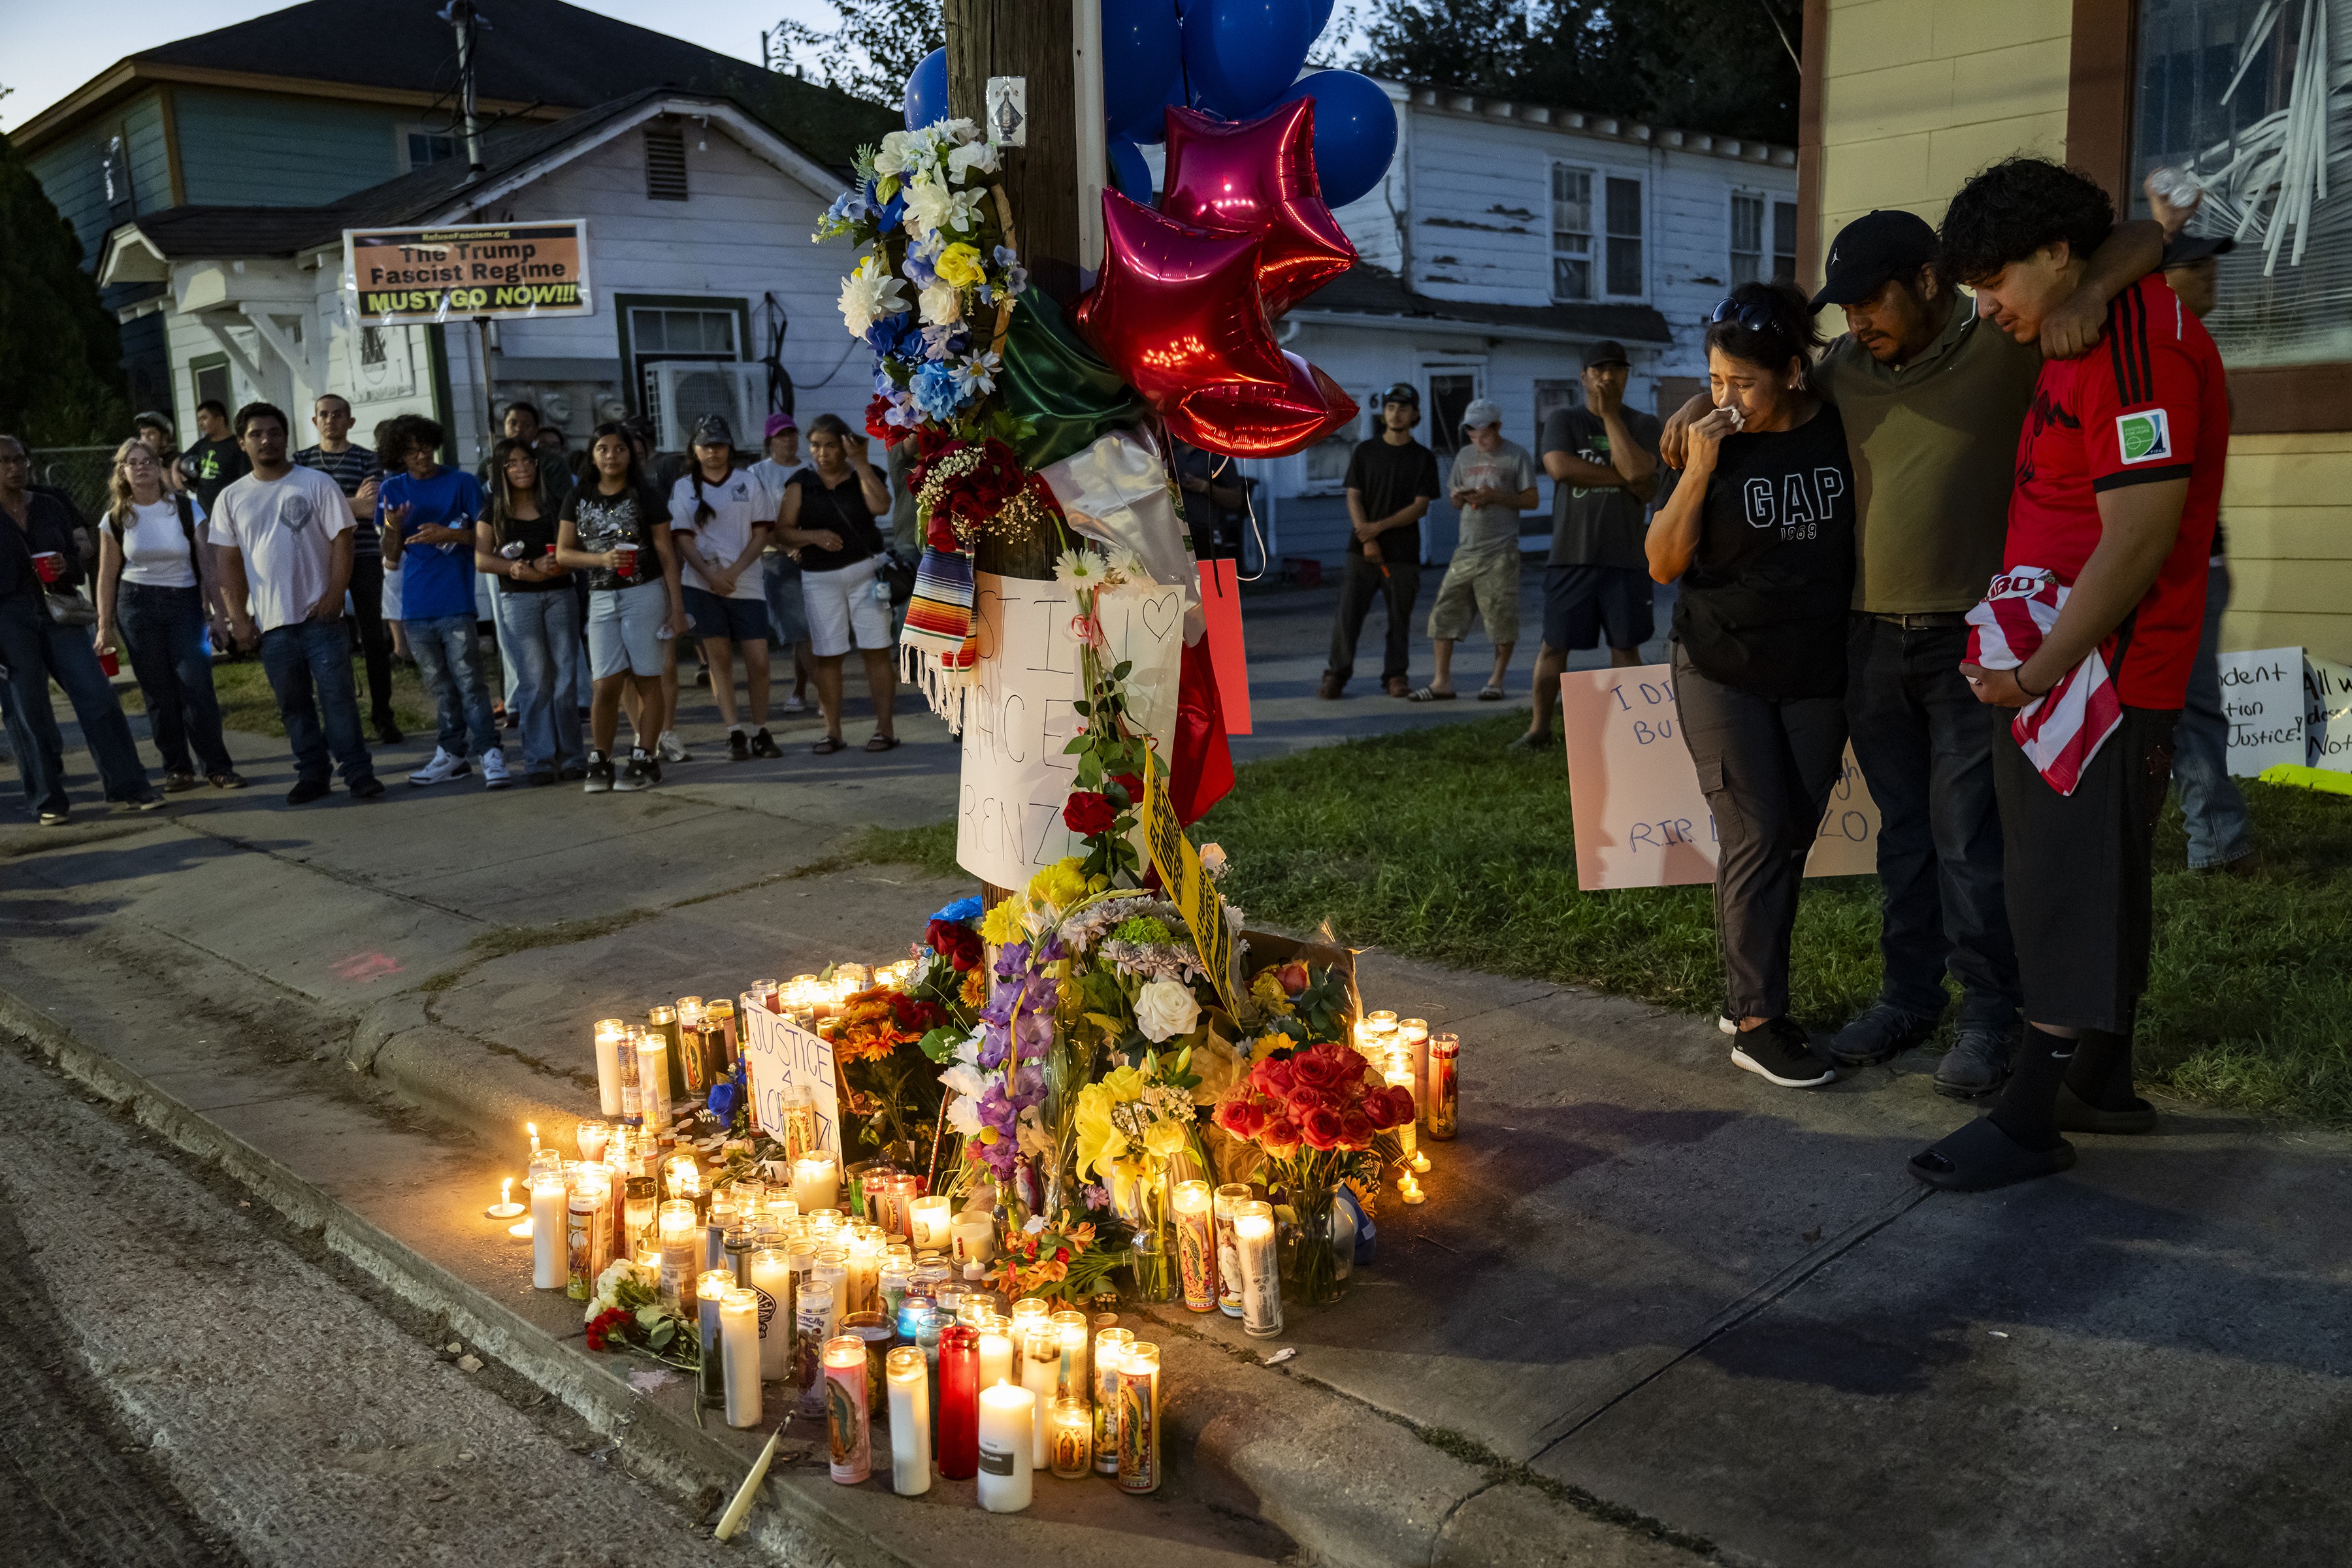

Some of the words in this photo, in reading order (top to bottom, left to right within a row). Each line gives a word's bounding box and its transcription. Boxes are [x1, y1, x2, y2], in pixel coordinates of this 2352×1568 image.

[401, 246, 446, 263] The
[458, 242, 536, 263] Trump
[370, 264, 463, 286] Fascist
[472, 263, 566, 284] Regime
[367, 290, 442, 312] MUST
[449, 288, 488, 306] GO
[495, 284, 577, 305] NOW!!!
[1744, 467, 1844, 529] GAP
[1780, 523, 1817, 542] 1969
[2219, 663, 2287, 686] dent
[2304, 668, 2332, 701] All
[1610, 684, 1632, 711] I
[1634, 719, 1679, 745] BU
[965, 785, 1071, 866] RENZ
[1159, 790, 1175, 880] UNIDO
[748, 1006, 833, 1088] JUSTICE
[782, 1070, 794, 1099] 4
